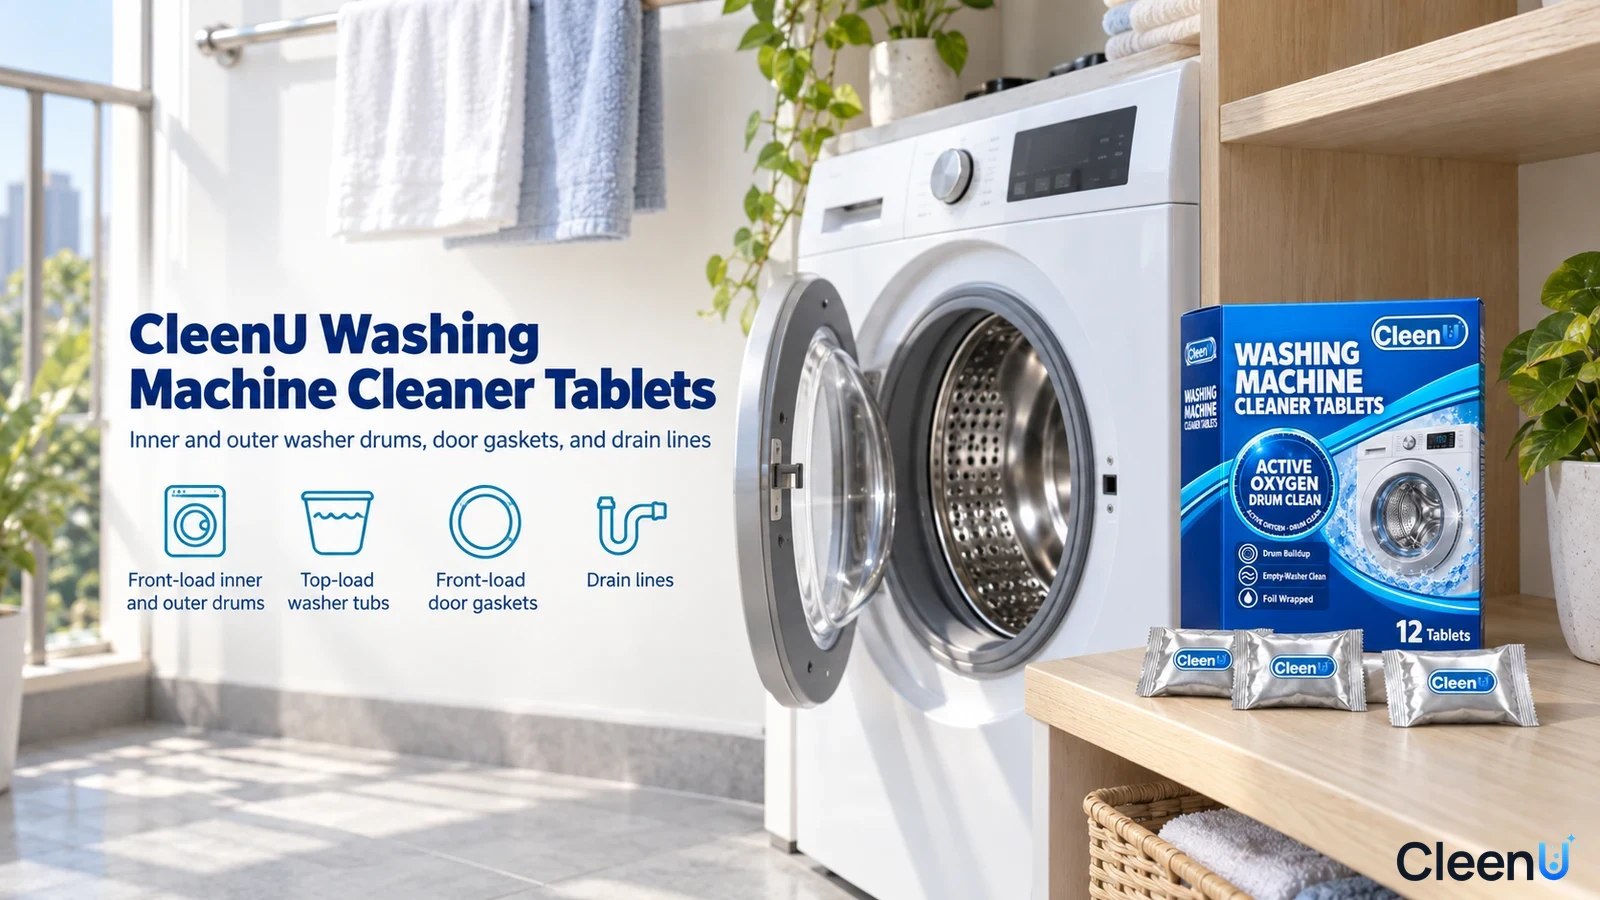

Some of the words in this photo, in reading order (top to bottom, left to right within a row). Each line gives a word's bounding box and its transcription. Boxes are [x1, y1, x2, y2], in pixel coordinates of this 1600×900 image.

[1234, 341, 1360, 366] WASHING
[1235, 368, 1363, 395] MACHINE
[1184, 385, 1217, 403] WASHING
[1184, 402, 1217, 419] MACHINE
[1234, 397, 1311, 415] CLEANER
[1314, 396, 1385, 415] TABLETS
[1256, 459, 1312, 474] ACTIVE
[1251, 475, 1319, 491] OXYGEN
[1249, 493, 1283, 506] DRUM
[1285, 493, 1322, 506] CLEAN
[1263, 549, 1282, 557] Drum
[1283, 549, 1311, 559] Buildup
[1263, 571, 1308, 581] Empty-Washer
[1309, 572, 1327, 580] Clean
[1263, 594, 1277, 603] Foil
[1279, 594, 1314, 605] Wrapped
[1396, 619, 1423, 643] 12
[1426, 627, 1471, 642] Tablets
